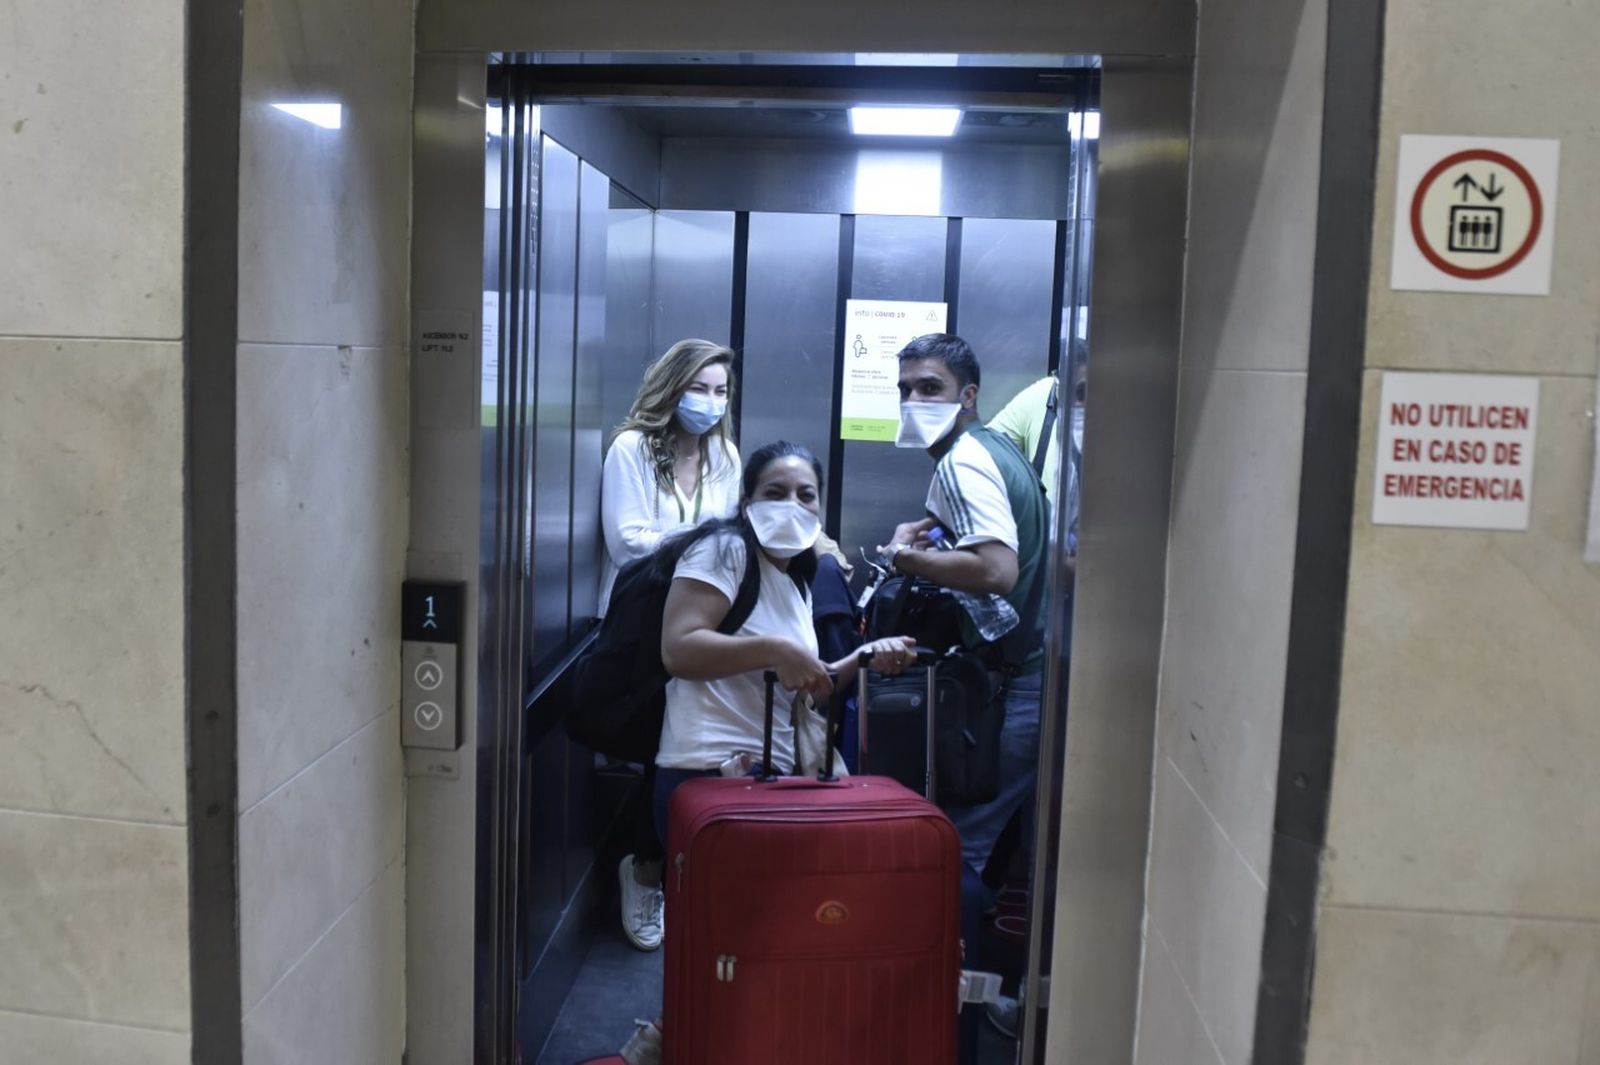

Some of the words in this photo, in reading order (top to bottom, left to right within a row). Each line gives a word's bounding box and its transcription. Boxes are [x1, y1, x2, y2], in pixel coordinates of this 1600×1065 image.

[1390, 403, 1421, 426] NO
[1429, 404, 1528, 429] UTILICEN
[1393, 439, 1421, 461] EN
[1429, 440, 1487, 464] CASO
[1494, 442, 1521, 465] DE
[1384, 474, 1524, 502] EMERGENCIA
[425, 596, 435, 617] 1
